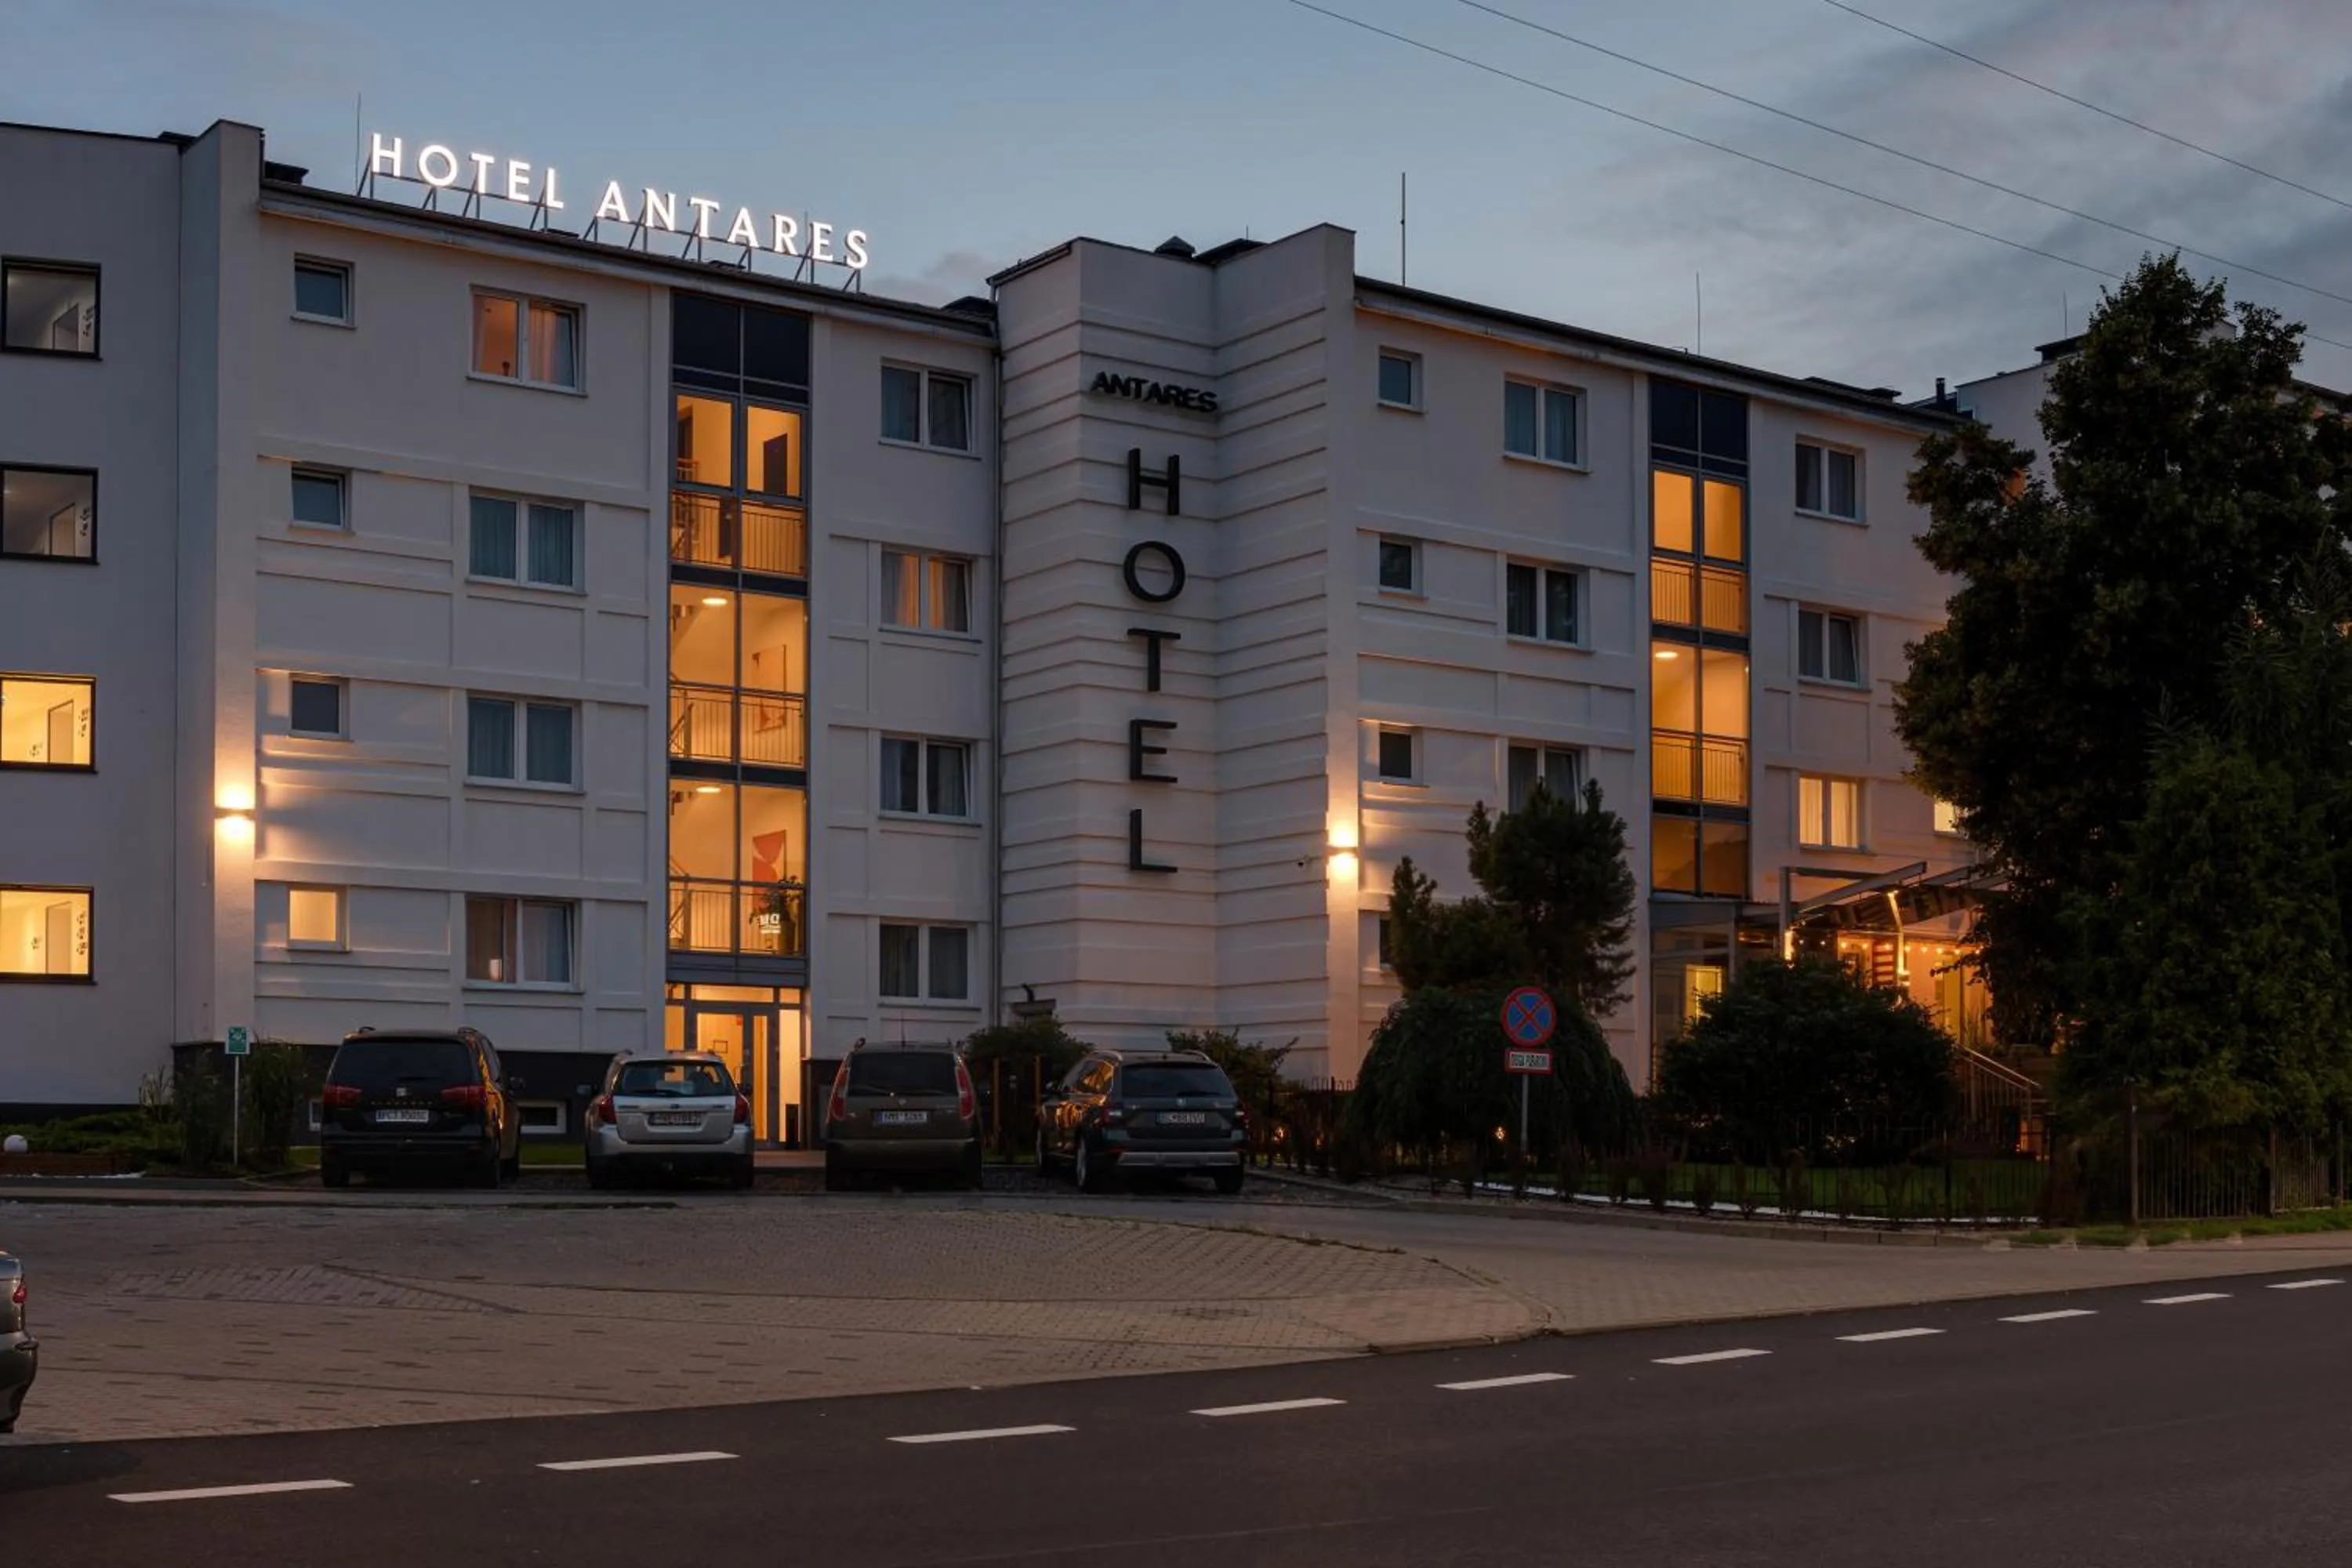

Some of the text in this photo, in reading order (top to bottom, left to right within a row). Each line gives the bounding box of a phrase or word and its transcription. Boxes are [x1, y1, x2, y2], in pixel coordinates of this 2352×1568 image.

[371, 132, 869, 270] HOTEL ANTARES
[1091, 371, 1218, 413] ANTARES
[1123, 447, 1186, 873] HOTEL
